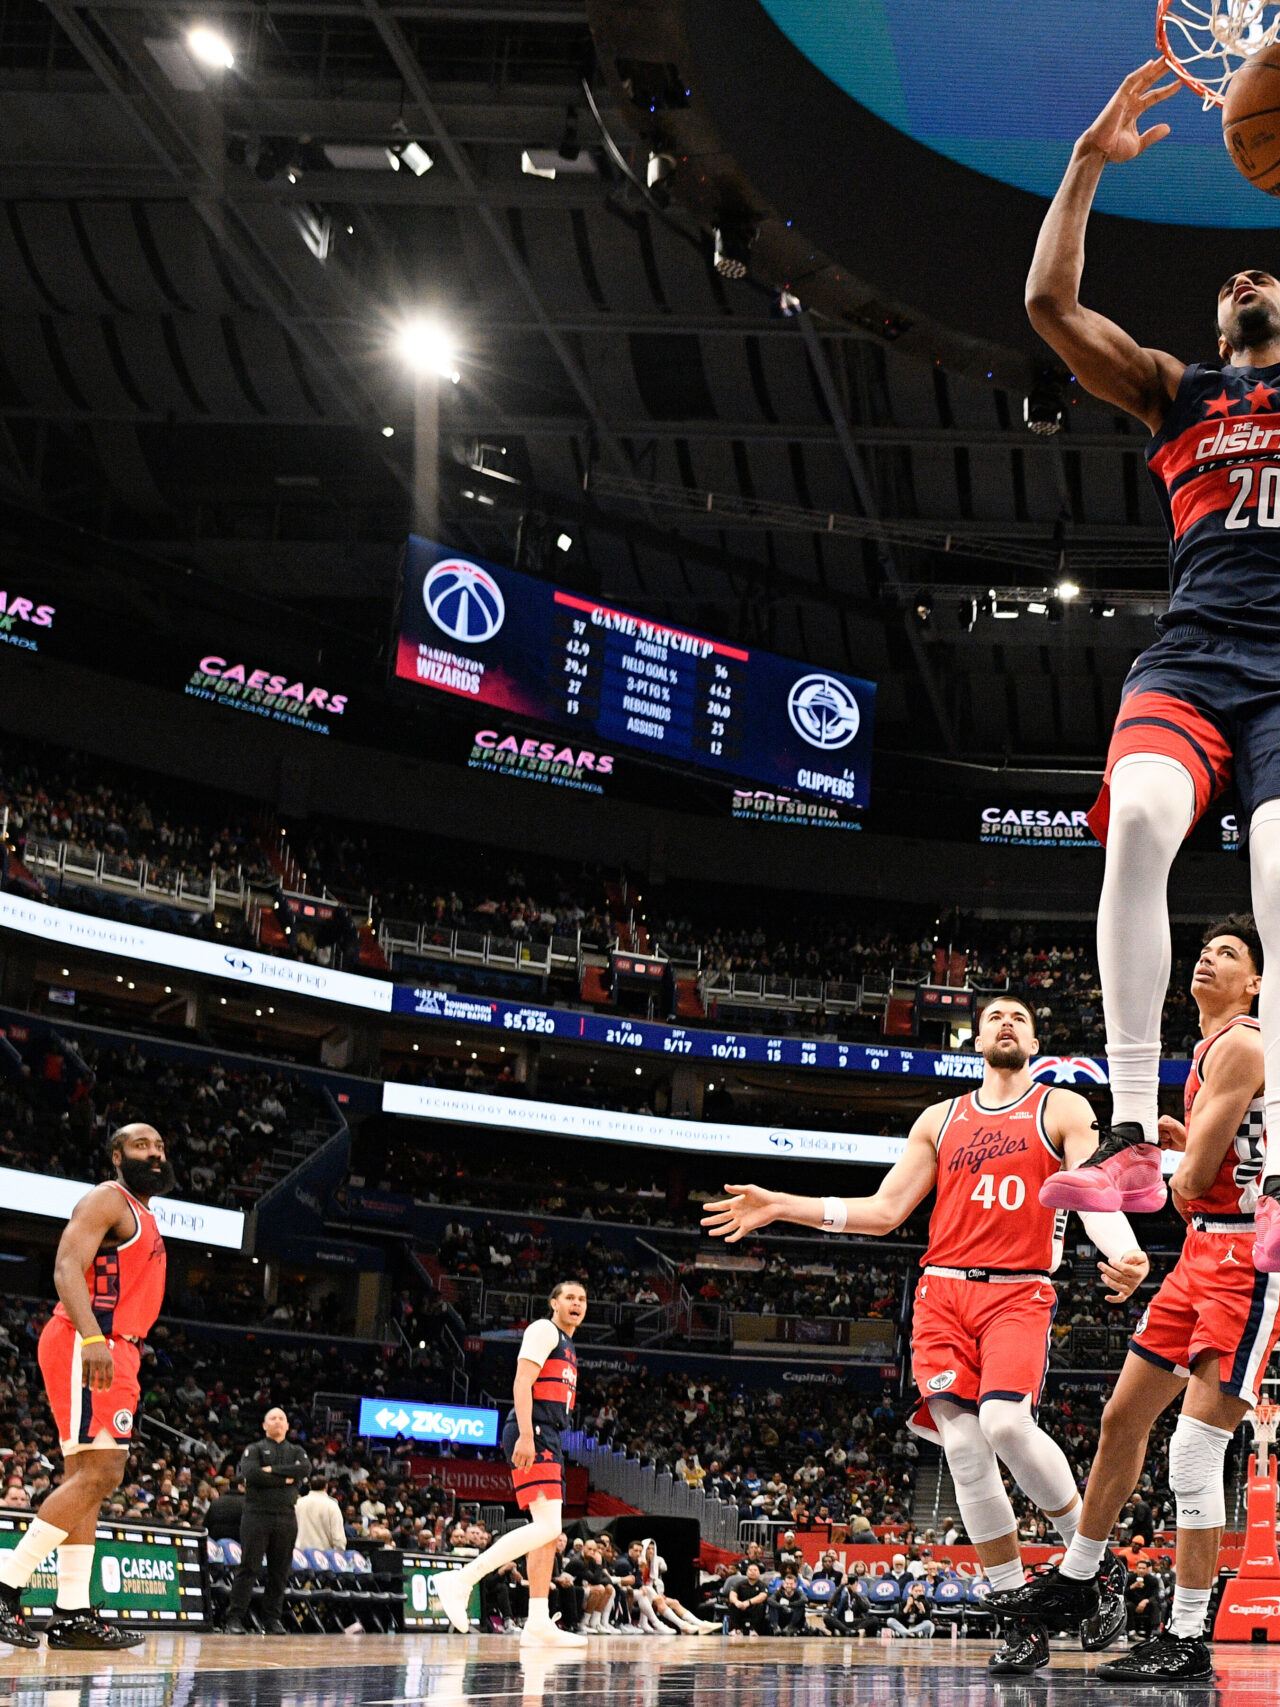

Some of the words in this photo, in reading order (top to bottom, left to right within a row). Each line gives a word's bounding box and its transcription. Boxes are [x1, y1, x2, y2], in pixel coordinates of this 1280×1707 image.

[1232, 421, 1253, 432] THE
[590, 607, 639, 637] GAME
[640, 622, 714, 659] MATCHUP
[418, 643, 485, 674] WASHINGTON
[571, 619, 587, 636] 57
[634, 640, 668, 662] POINTS
[713, 663, 728, 681] 56
[416, 656, 480, 695] WIZARDS
[565, 639, 590, 657] 42.9
[621, 654, 643, 674] FIELD
[644, 659, 666, 680] GOAL
[708, 683, 731, 700] 44.2
[189, 670, 313, 718] SPORTSBOOK
[199, 656, 348, 714] CAESARS
[564, 659, 588, 677] 29.4
[626, 677, 647, 694] 3-PT
[706, 701, 730, 718] 20.0
[567, 679, 581, 695] 27
[622, 697, 671, 722] REBOUNDS
[711, 721, 724, 737] 25
[566, 700, 579, 715] 15
[626, 717, 664, 740] ASSISTS
[709, 740, 722, 756] 12
[474, 729, 615, 775] CAESARS
[470, 746, 584, 781] SPORTSBOOK
[797, 768, 855, 799] CLIPPERS
[732, 797, 839, 820] SPORTSBOOK
[981, 807, 1089, 827] CAESAR
[981, 823, 1084, 839] SPORTSBOOK
[433, 990, 448, 1001] PM
[444, 1000, 492, 1014] FOUNDATION
[466, 1011, 492, 1022] RAFFLE
[503, 1012, 555, 1034] $5,920
[621, 1021, 632, 1031] FG
[606, 1029, 643, 1047] 21/49
[664, 1037, 693, 1053] 5/17
[767, 1039, 782, 1049] AST
[802, 1042, 816, 1052] REB
[711, 1043, 746, 1060] 10/13
[766, 1048, 781, 1063] 15
[801, 1051, 817, 1065] 36
[838, 1045, 849, 1054] TO
[865, 1048, 889, 1058] FOULS
[900, 1051, 914, 1060] TOL
[839, 1054, 847, 1068] 9
[871, 1056, 880, 1070] 0
[901, 1060, 909, 1073] 5
[942, 1054, 984, 1065] WASHINGT
[934, 1061, 984, 1079] WIZAR
[419, 1096, 503, 1115] TECHNOLOGY
[508, 1109, 557, 1122] MOVING
[968, 1127, 1003, 1149] Los
[948, 1136, 1029, 1174] Angeles
[970, 1174, 1026, 1210] 40
[967, 1268, 986, 1279] Clips
[412, 1410, 484, 1439] ZKsync
[121, 1556, 175, 1581] CAESARS
[122, 1578, 168, 1595] SPORTSBOOK
